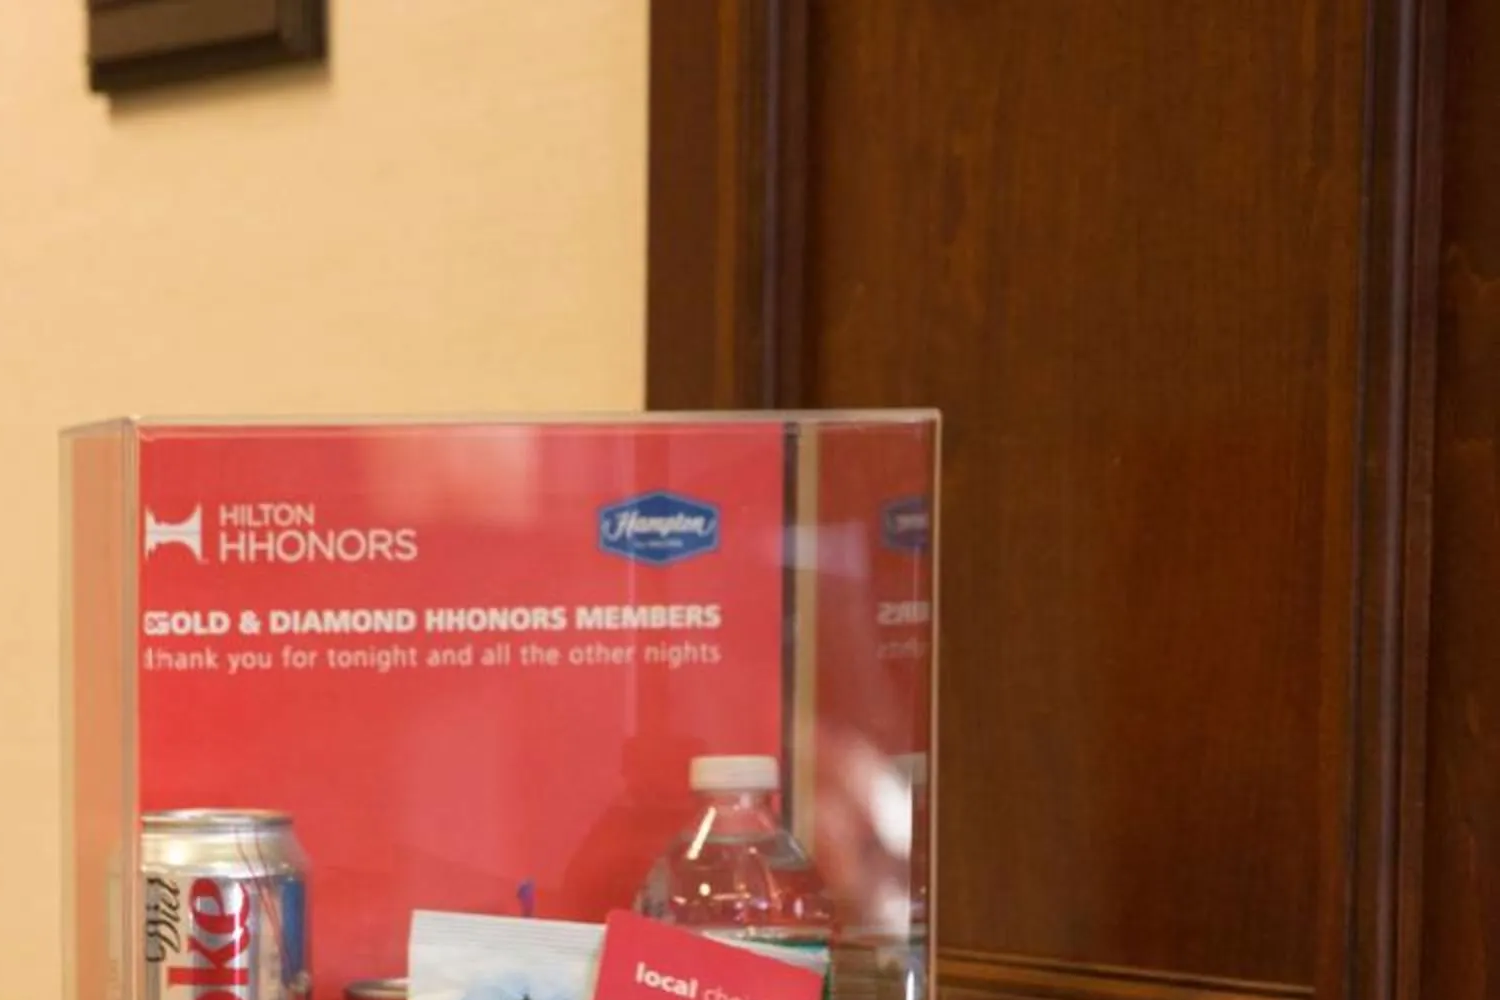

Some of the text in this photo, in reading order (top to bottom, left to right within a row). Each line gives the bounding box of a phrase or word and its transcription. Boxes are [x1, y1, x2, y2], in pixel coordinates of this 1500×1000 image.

[219, 503, 316, 527] HILTON
[602, 510, 716, 541] Hampton
[219, 529, 418, 563] HHONORS
[144, 604, 722, 636] GOLD & DIAMOND HHONORS MEMBERS
[144, 639, 722, 675] thank you for tonight and all the other nights
[634, 961, 699, 999] local
